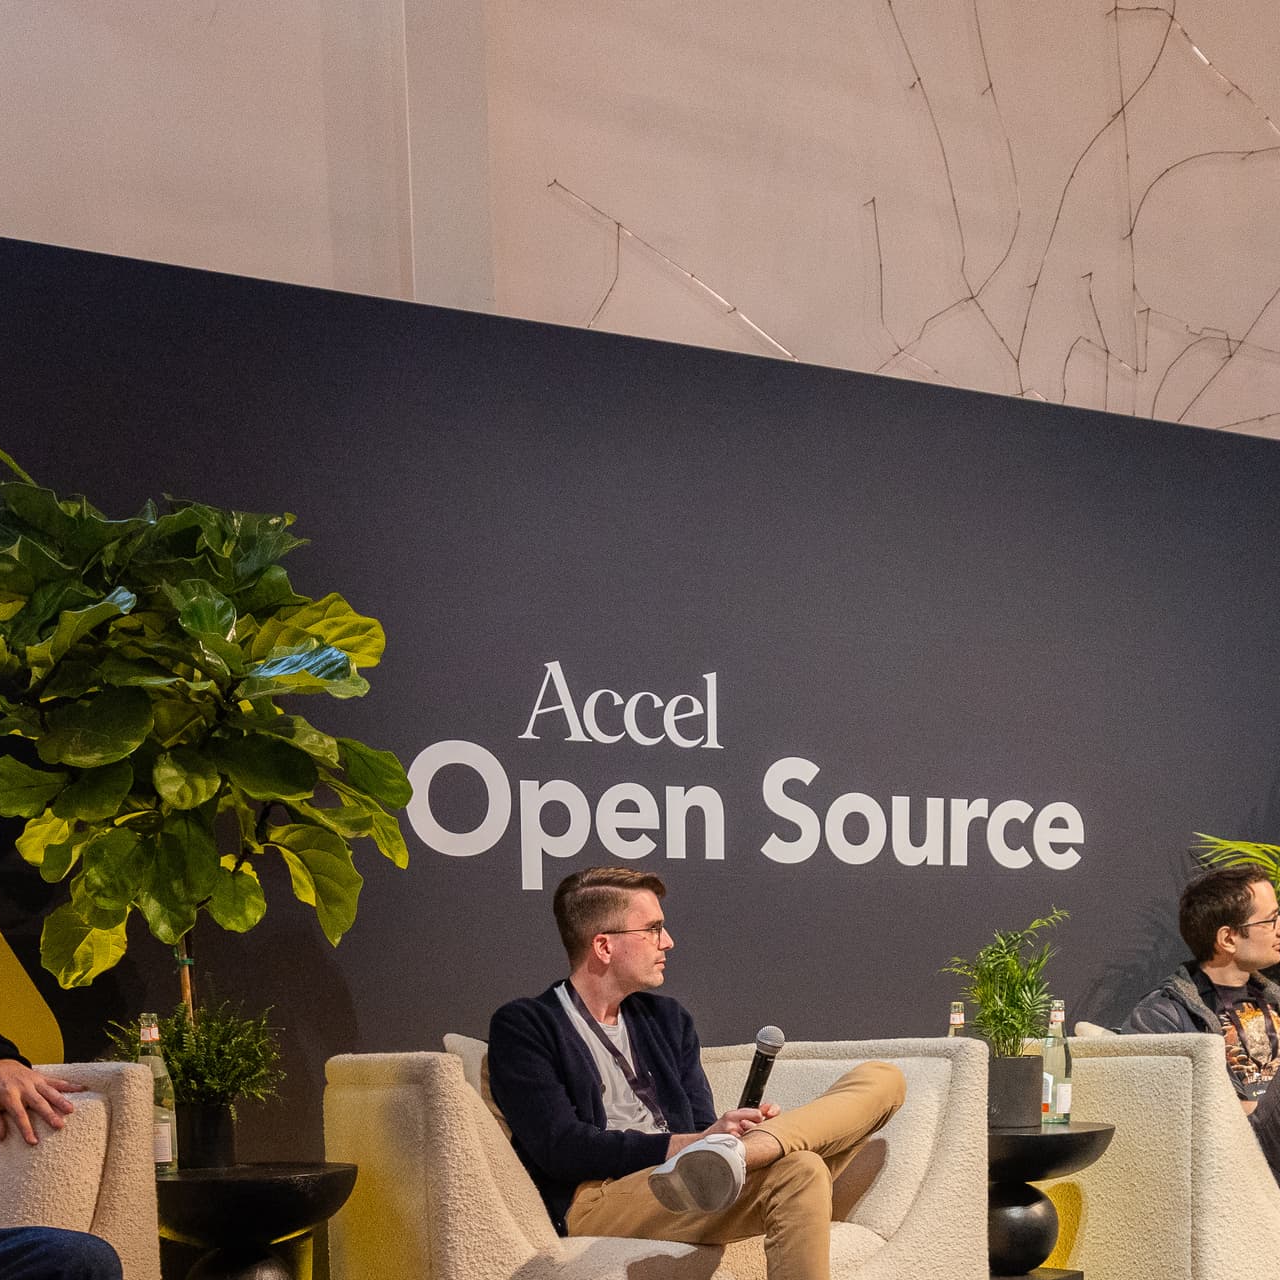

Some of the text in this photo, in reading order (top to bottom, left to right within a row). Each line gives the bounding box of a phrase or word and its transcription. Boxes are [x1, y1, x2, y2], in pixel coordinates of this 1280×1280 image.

[517, 660, 724, 750] Accel
[406, 739, 1086, 890] Open Source
